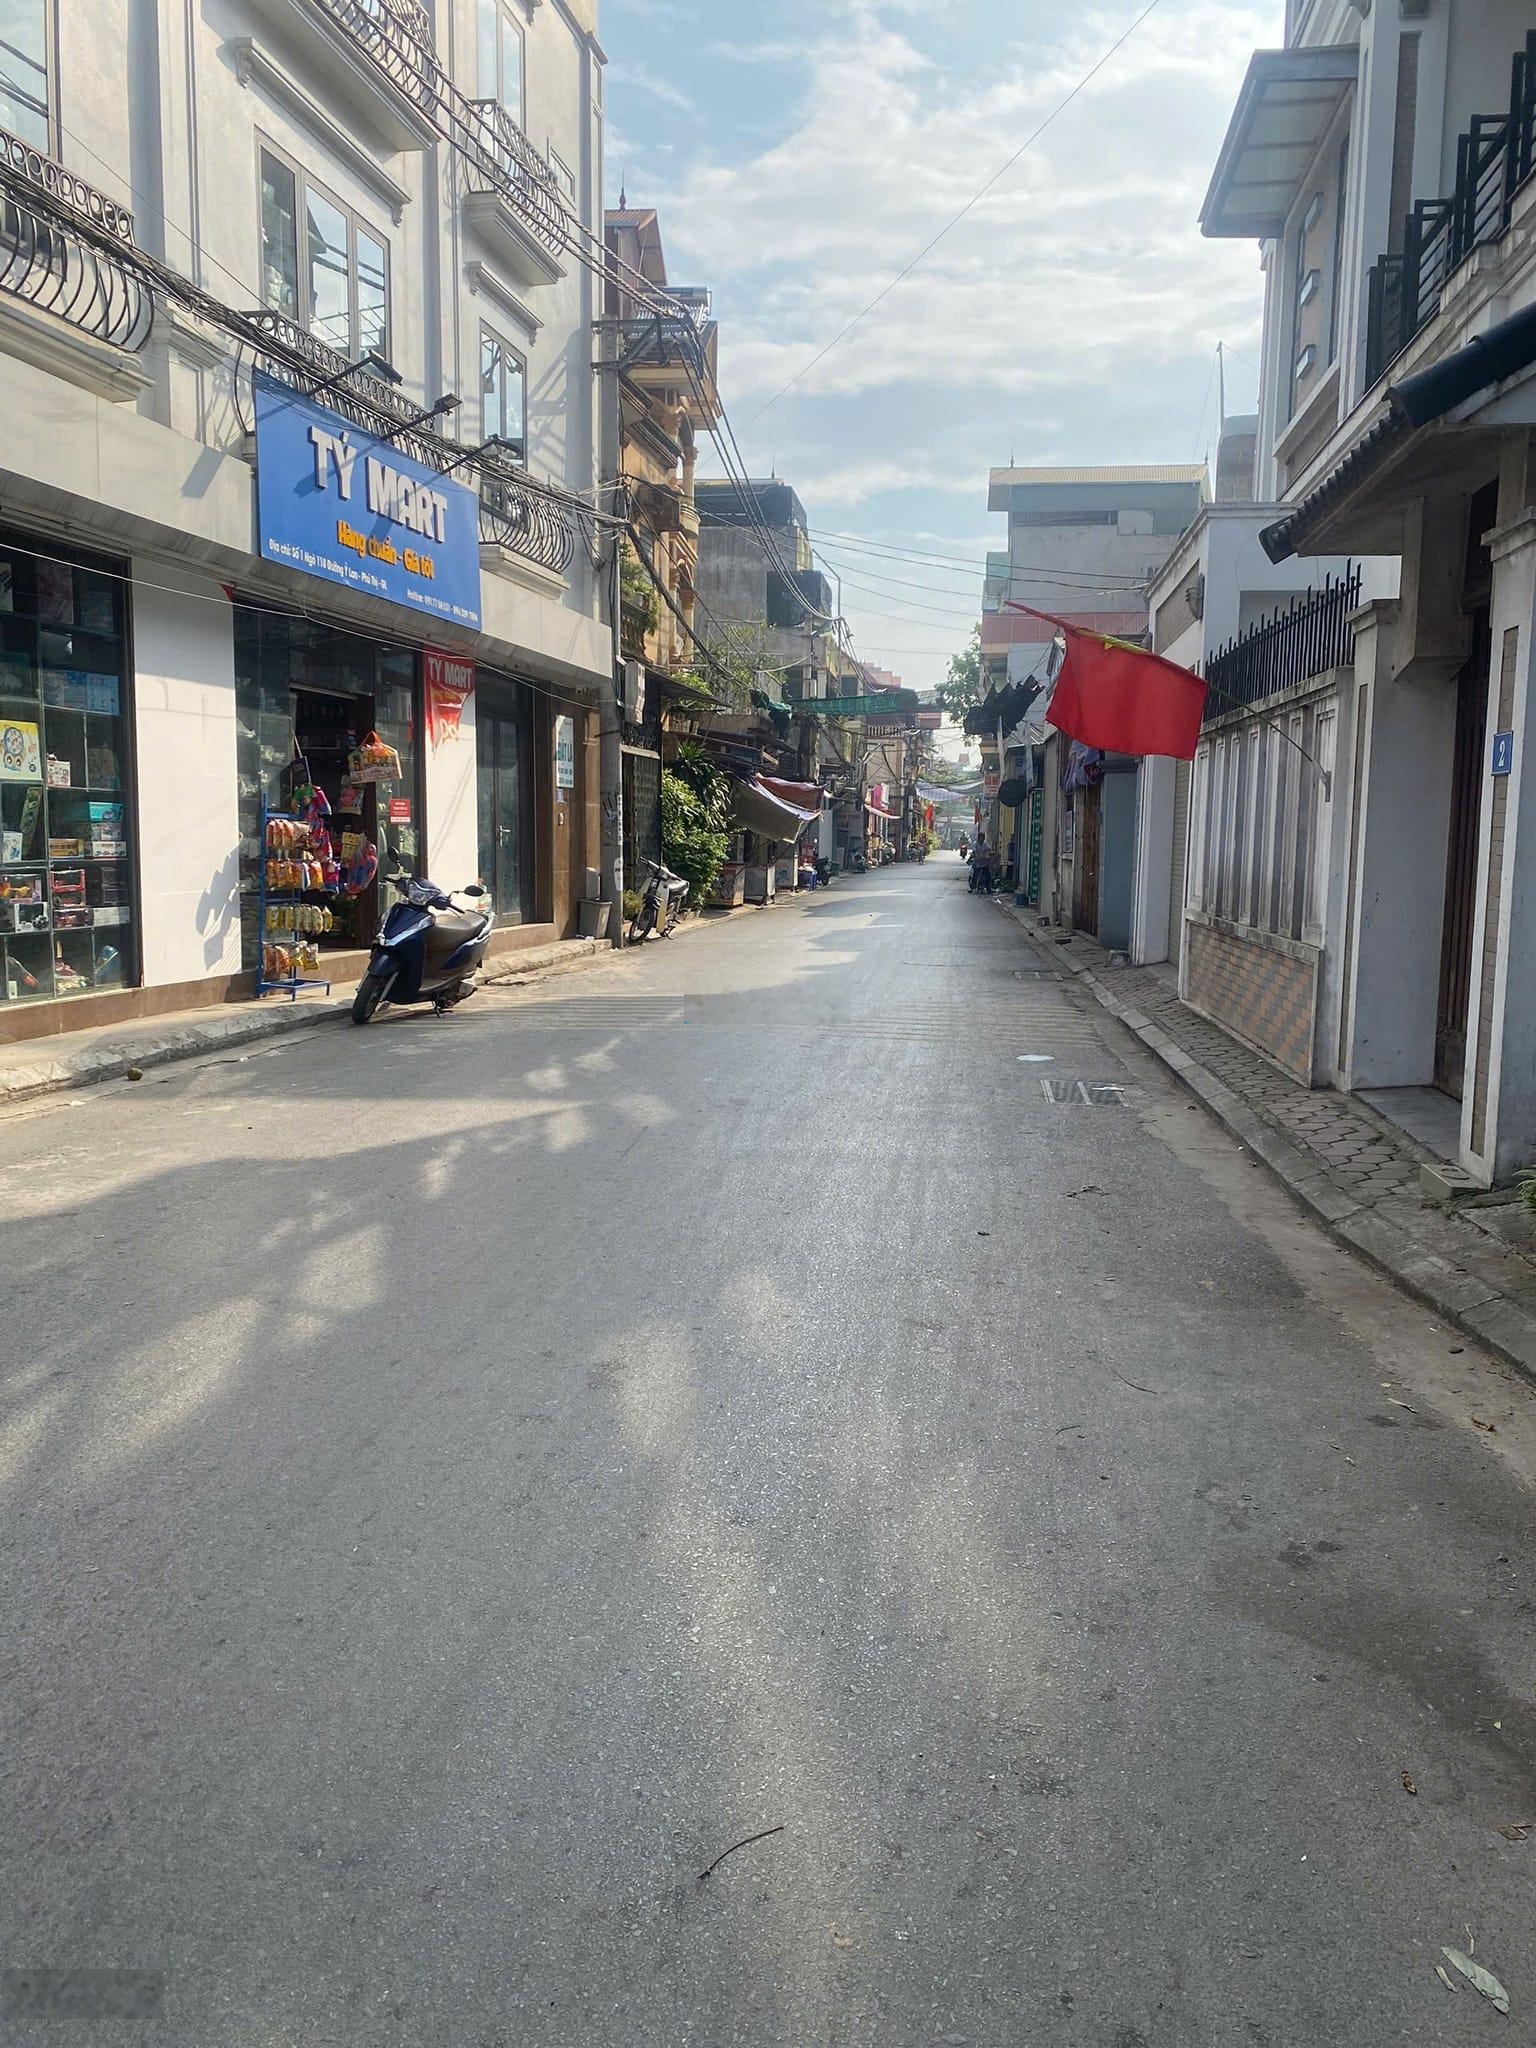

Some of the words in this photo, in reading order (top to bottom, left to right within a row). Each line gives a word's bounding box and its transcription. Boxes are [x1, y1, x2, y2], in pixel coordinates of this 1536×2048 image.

[365, 456, 447, 543] MART
[336, 519, 367, 558] Hàng
[292, 546, 299, 560] Số
[445, 662, 472, 688] MART
[1498, 740, 1506, 767] 2
